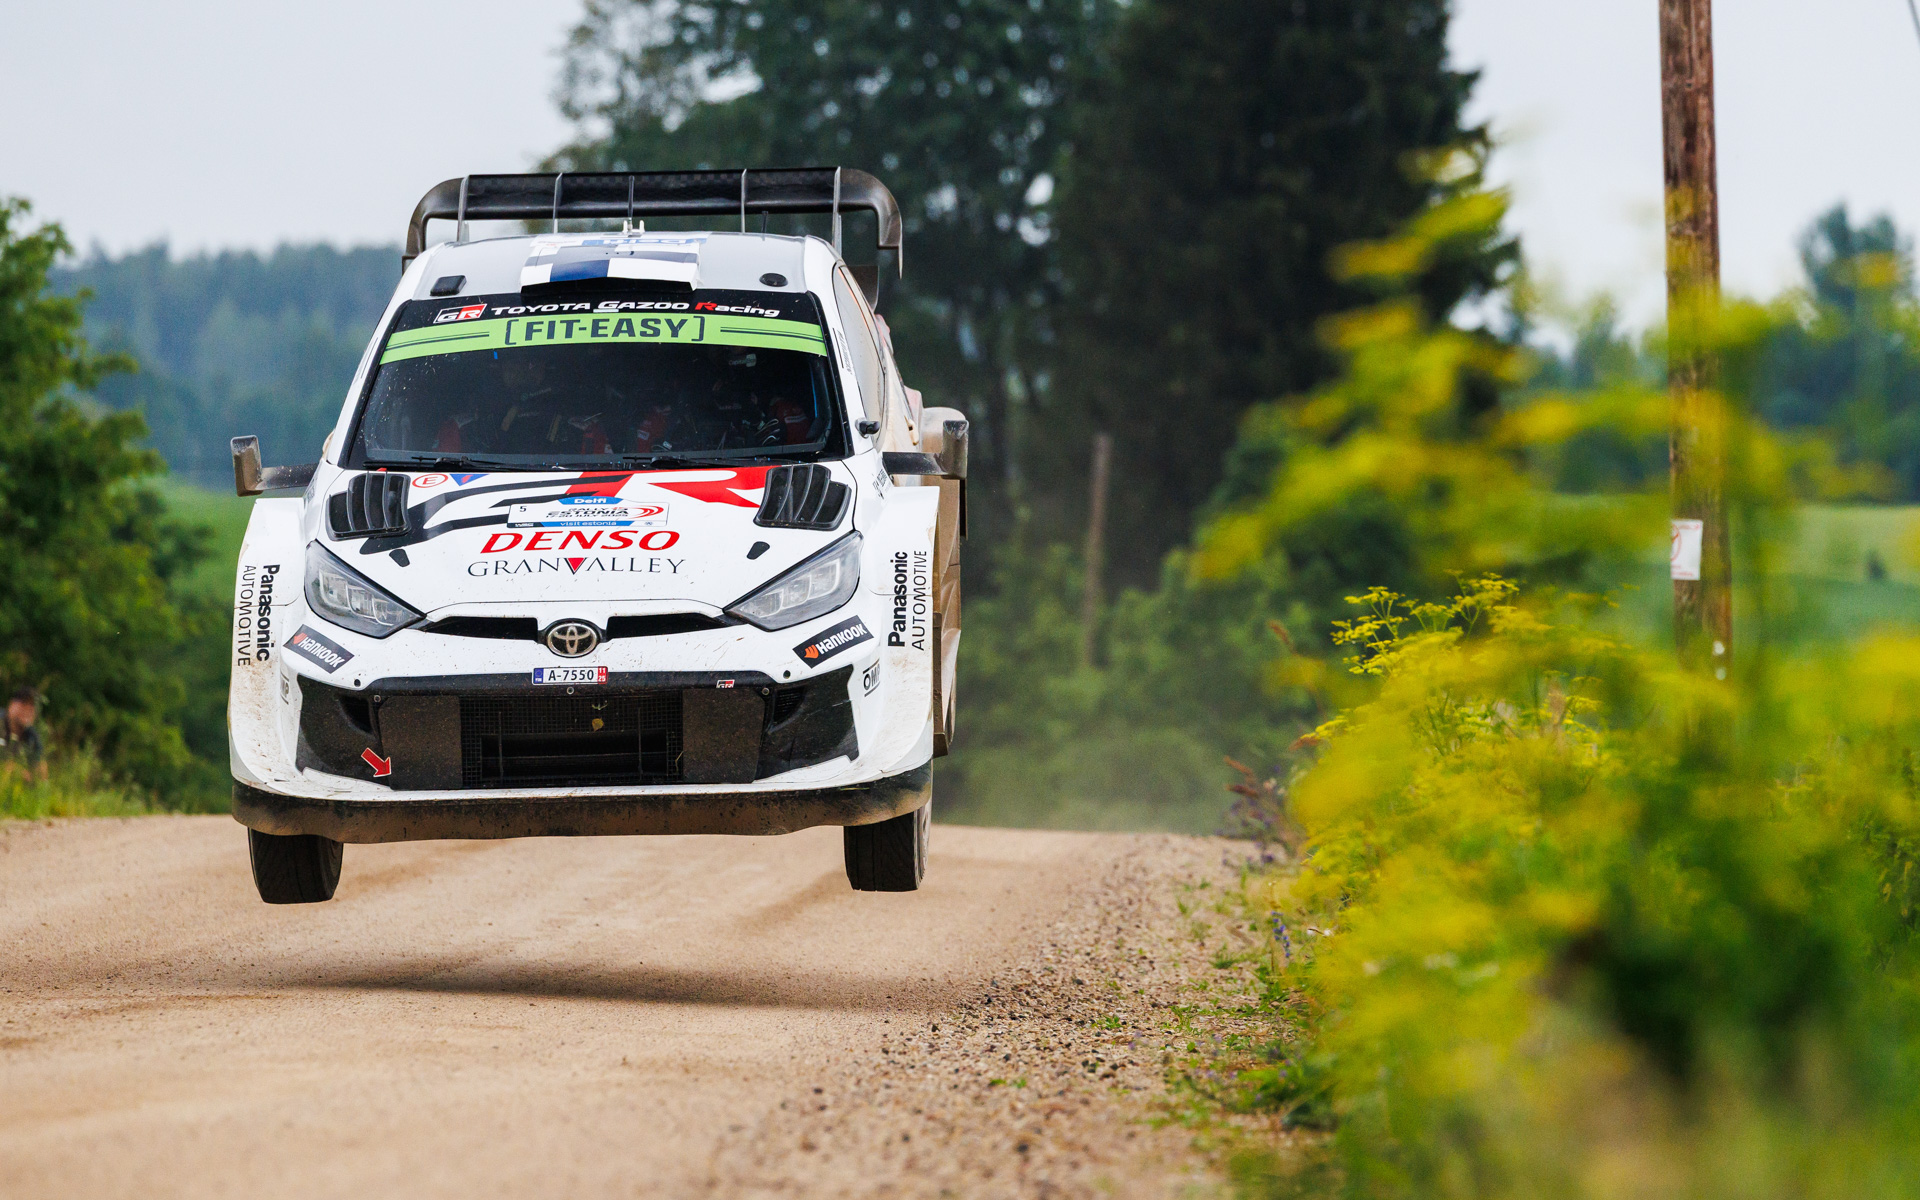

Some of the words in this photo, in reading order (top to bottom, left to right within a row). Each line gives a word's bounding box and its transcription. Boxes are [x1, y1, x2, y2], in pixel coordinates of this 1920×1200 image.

[440, 305, 482, 322] GR
[491, 303, 592, 316] TOYOTA
[596, 301, 690, 312] GAZOO
[695, 302, 780, 318] Racing
[467, 557, 686, 577] GRANVALLEY
[480, 530, 680, 554] DENSO
[238, 565, 257, 667] AUTOMOTIVE
[256, 564, 280, 662] Panasonic
[888, 551, 908, 647] Panasonic
[912, 550, 927, 651] AUTOMOTIVE
[548, 669, 594, 681] A-7550
